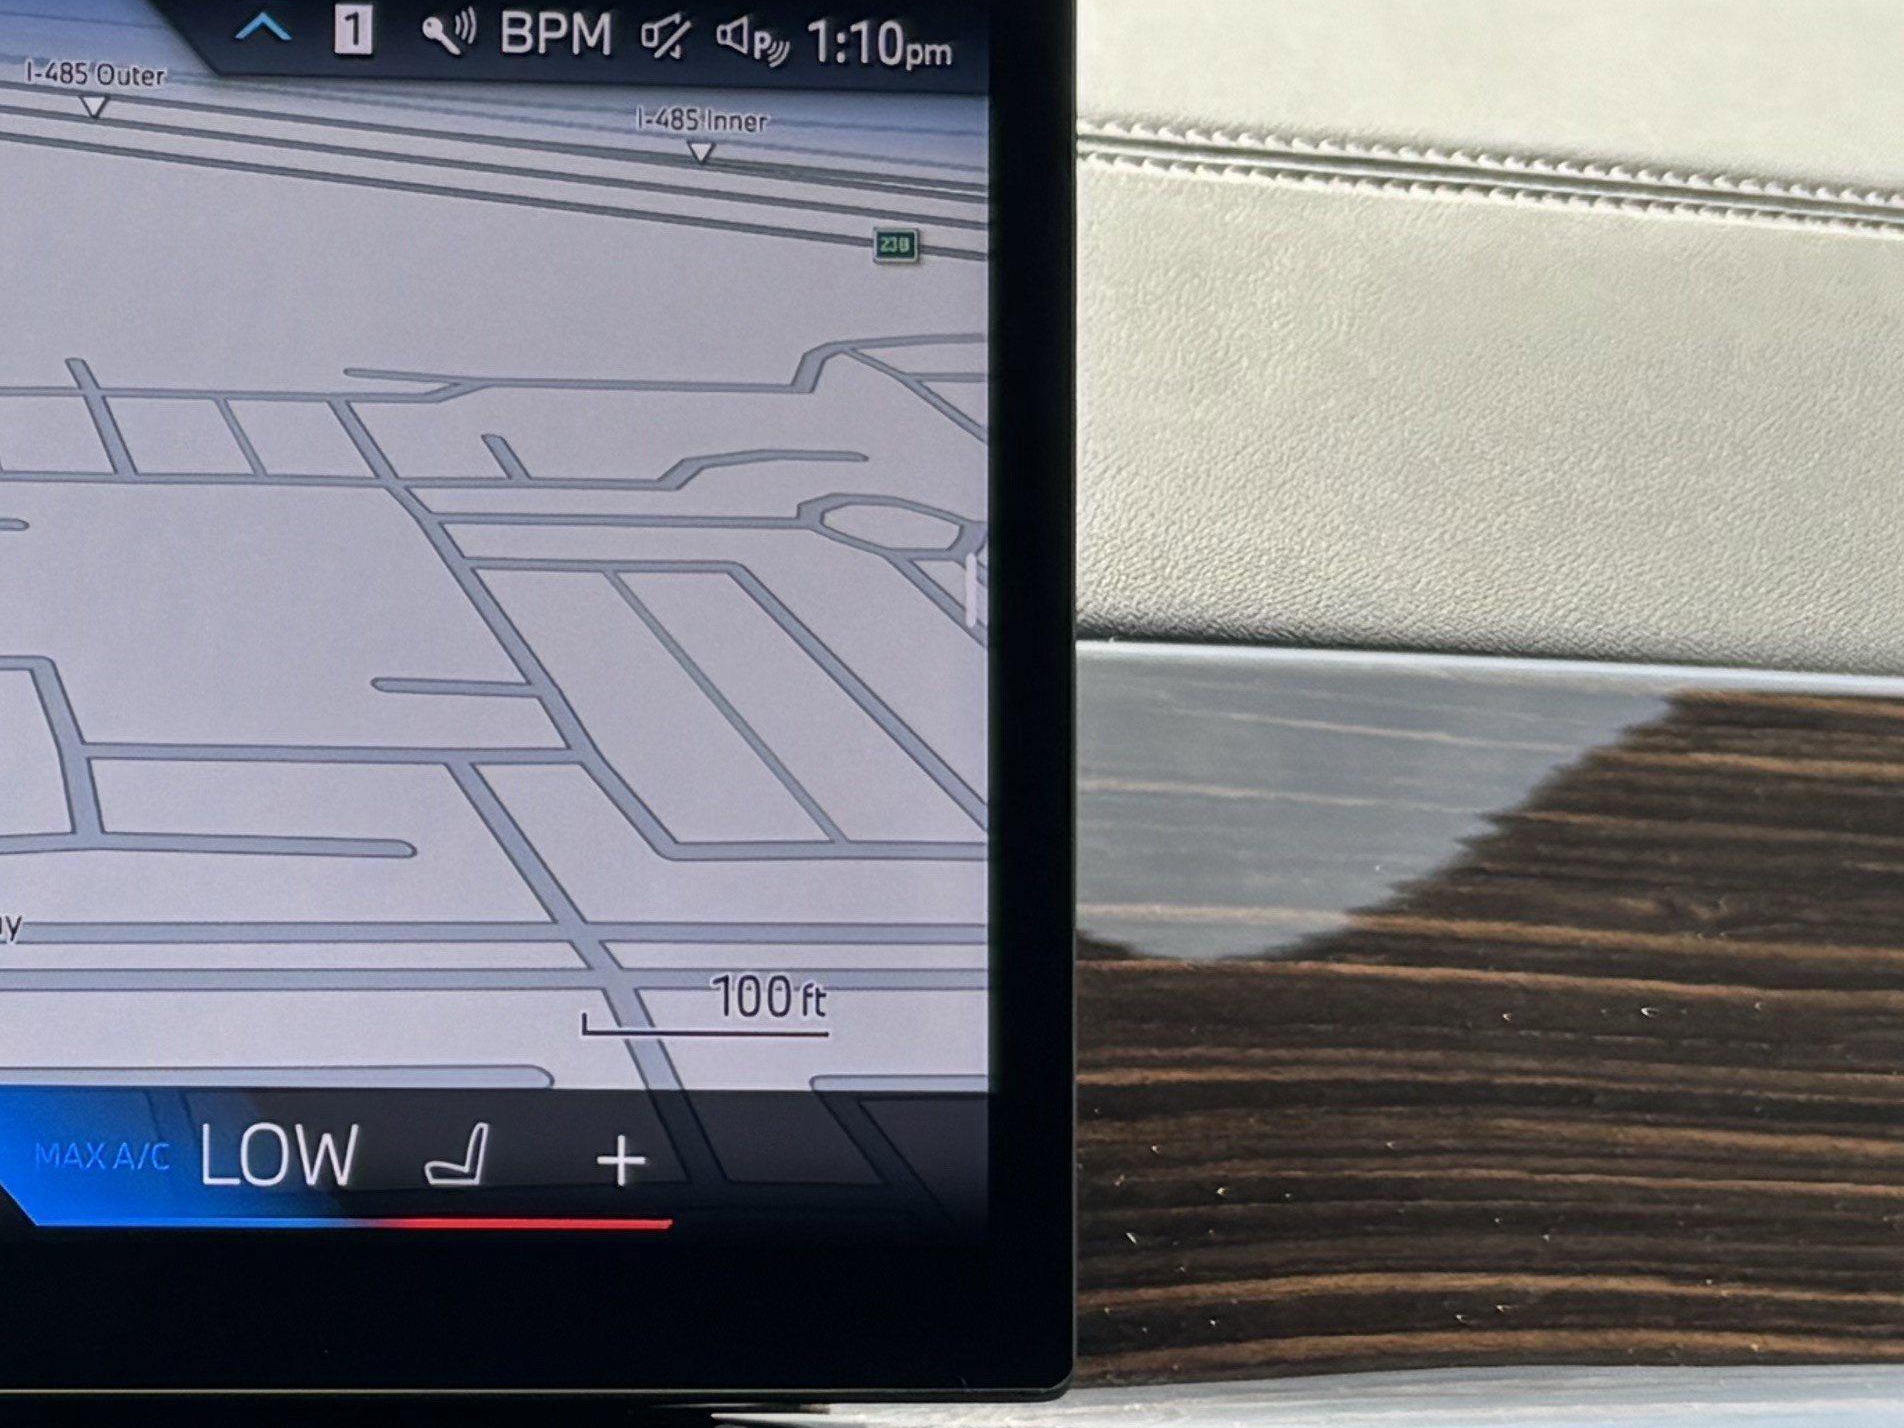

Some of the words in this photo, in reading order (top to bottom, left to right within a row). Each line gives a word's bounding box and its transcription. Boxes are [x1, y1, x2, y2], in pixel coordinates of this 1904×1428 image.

[502, 10, 612, 56] BPM
[808, 19, 953, 71] 1:10pm
[27, 61, 88, 86] I-485
[96, 63, 165, 86] Outer
[637, 106, 699, 131] I-485
[707, 110, 768, 132] Inner
[711, 974, 792, 1018] 100
[802, 982, 827, 1017] ft
[34, 1142, 106, 1171] MAX
[112, 1142, 171, 1171] A/C
[202, 1121, 360, 1187] LOW
